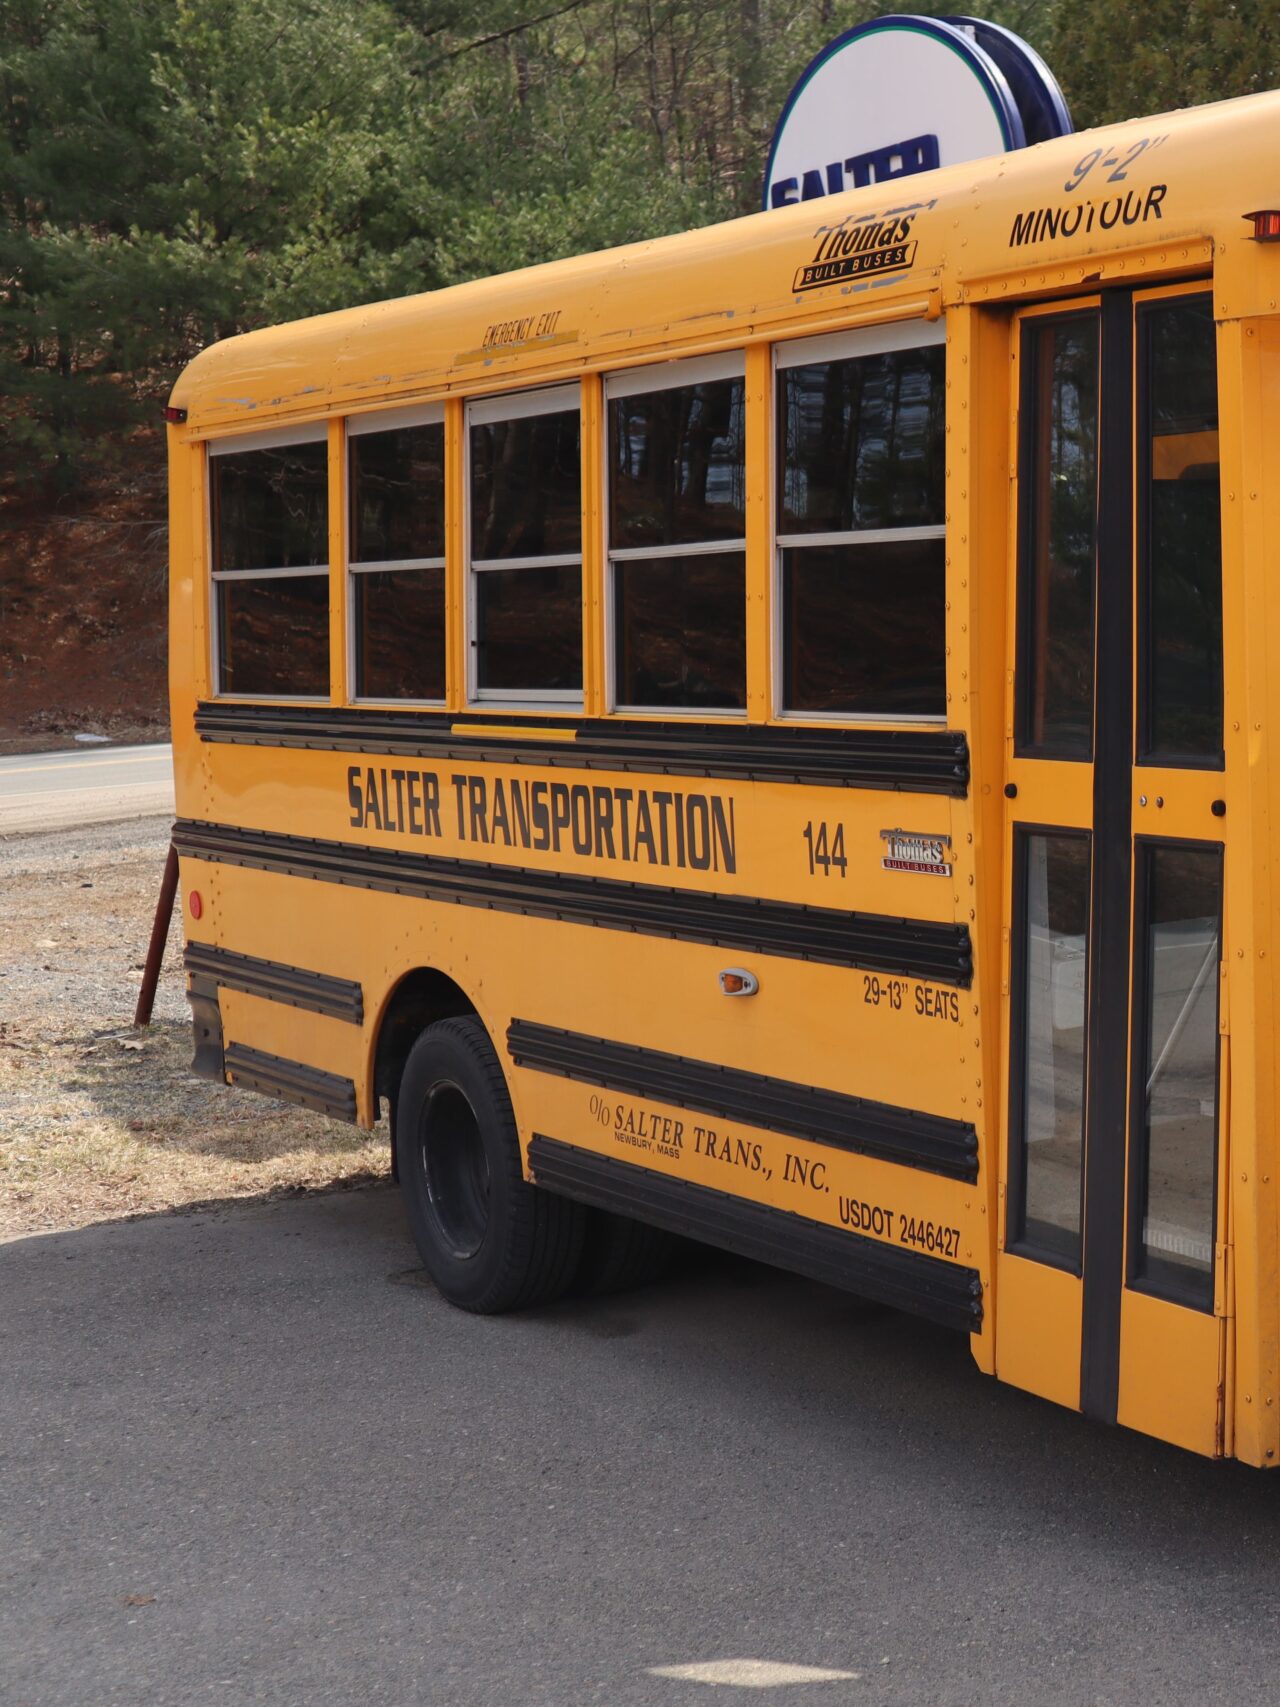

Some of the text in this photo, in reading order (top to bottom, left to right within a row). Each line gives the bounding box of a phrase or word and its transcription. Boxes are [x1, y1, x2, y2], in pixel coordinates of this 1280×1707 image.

[812, 200, 930, 263] Thomas
[805, 248, 903, 282] BUILT BUSES
[536, 310, 562, 336] EXIT
[347, 766, 737, 875] SALTER TRANSPORTATION
[803, 820, 848, 878] 144
[880, 828, 952, 864] Thomas
[886, 860, 945, 874] BUILT BUSES
[915, 985, 959, 1023] SEATS
[614, 1104, 684, 1149] SALTER
[693, 1126, 773, 1182] TRANS.,
[782, 1153, 830, 1194] INC.
[657, 1144, 680, 1160] MASS
[839, 1195, 960, 1259] USDOT 2446427
